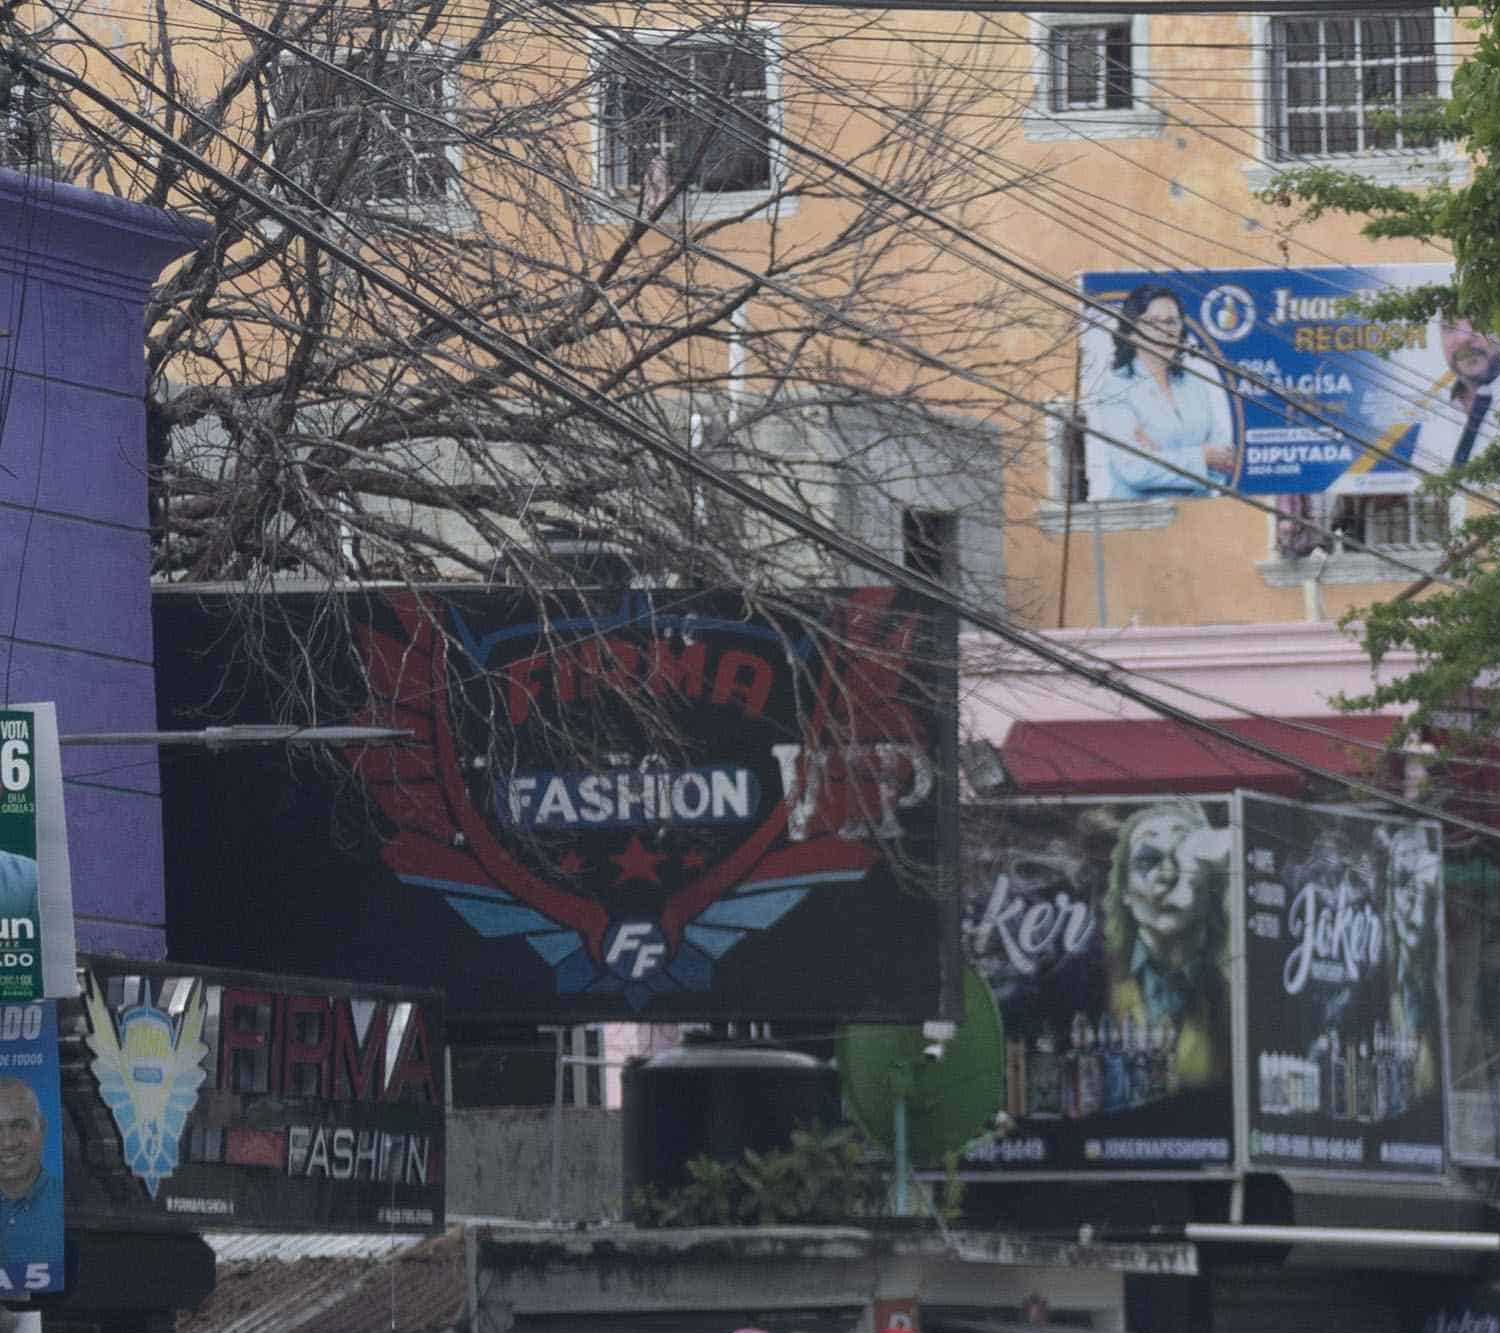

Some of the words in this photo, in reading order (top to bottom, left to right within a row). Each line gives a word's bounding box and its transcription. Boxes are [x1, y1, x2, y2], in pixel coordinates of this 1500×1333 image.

[508, 637, 775, 725] FIRMA
[1, 720, 28, 740] VOTA
[1, 739, 30, 791] 6
[508, 767, 749, 827] FASHION
[1284, 880, 1383, 996] Joker
[25, 1263, 51, 1289] 5
